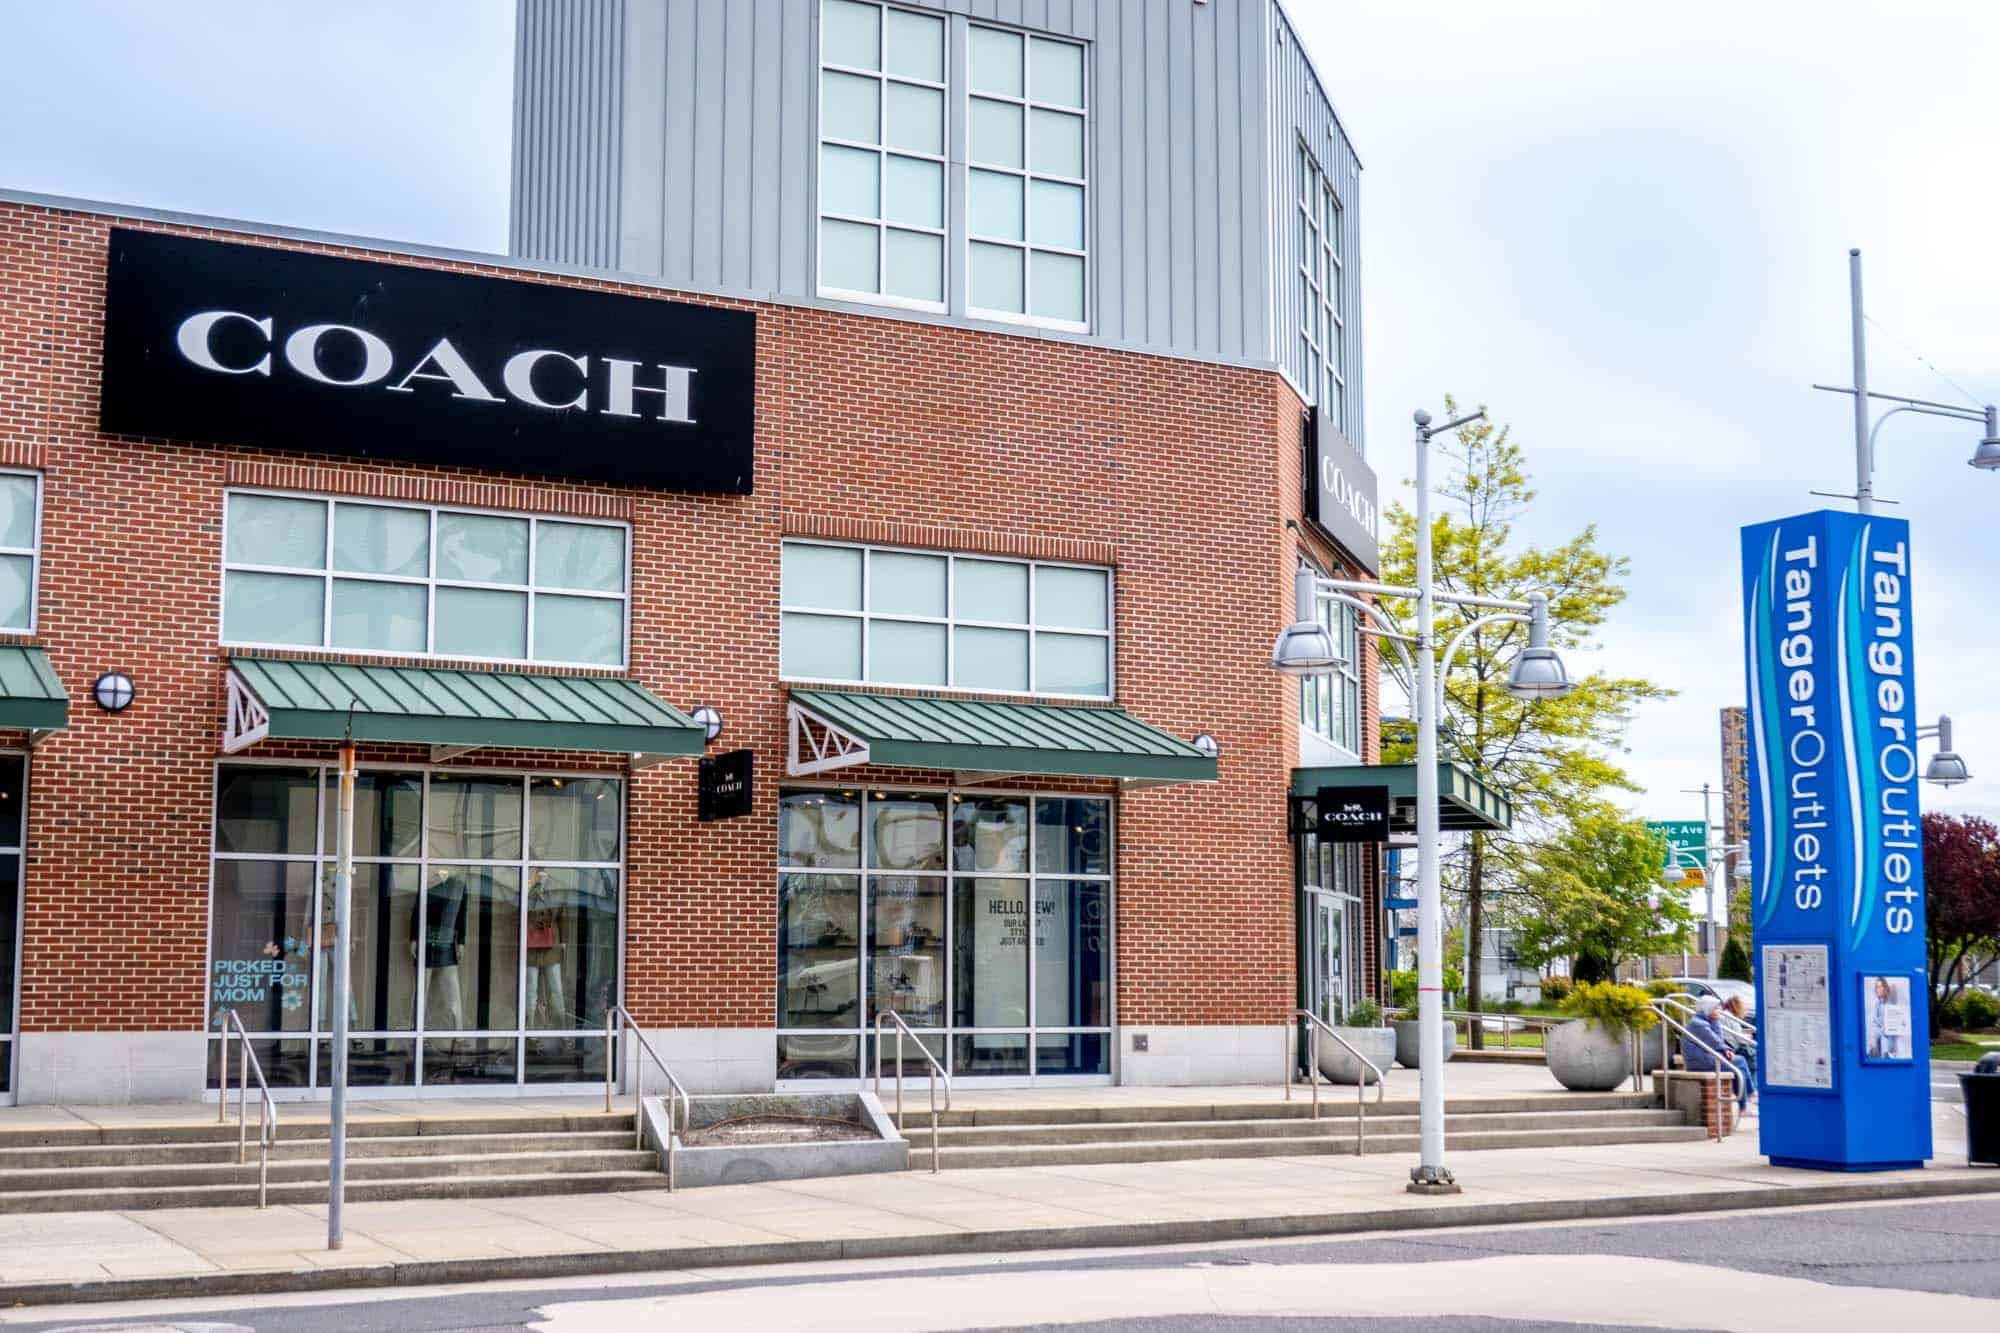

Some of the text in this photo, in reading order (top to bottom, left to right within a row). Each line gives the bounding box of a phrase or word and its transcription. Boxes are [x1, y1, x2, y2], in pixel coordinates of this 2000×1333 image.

[176, 310, 698, 423] COACH
[1323, 455, 1376, 541] COACH
[716, 780, 743, 793] COACH
[1324, 811, 1383, 822] COACH
[1680, 825, 1703, 834] Ave
[1035, 900, 1056, 915] EW!
[214, 960, 287, 974] PICKED
[213, 974, 309, 988] JUST FOR
[213, 988, 266, 1002] MOM
